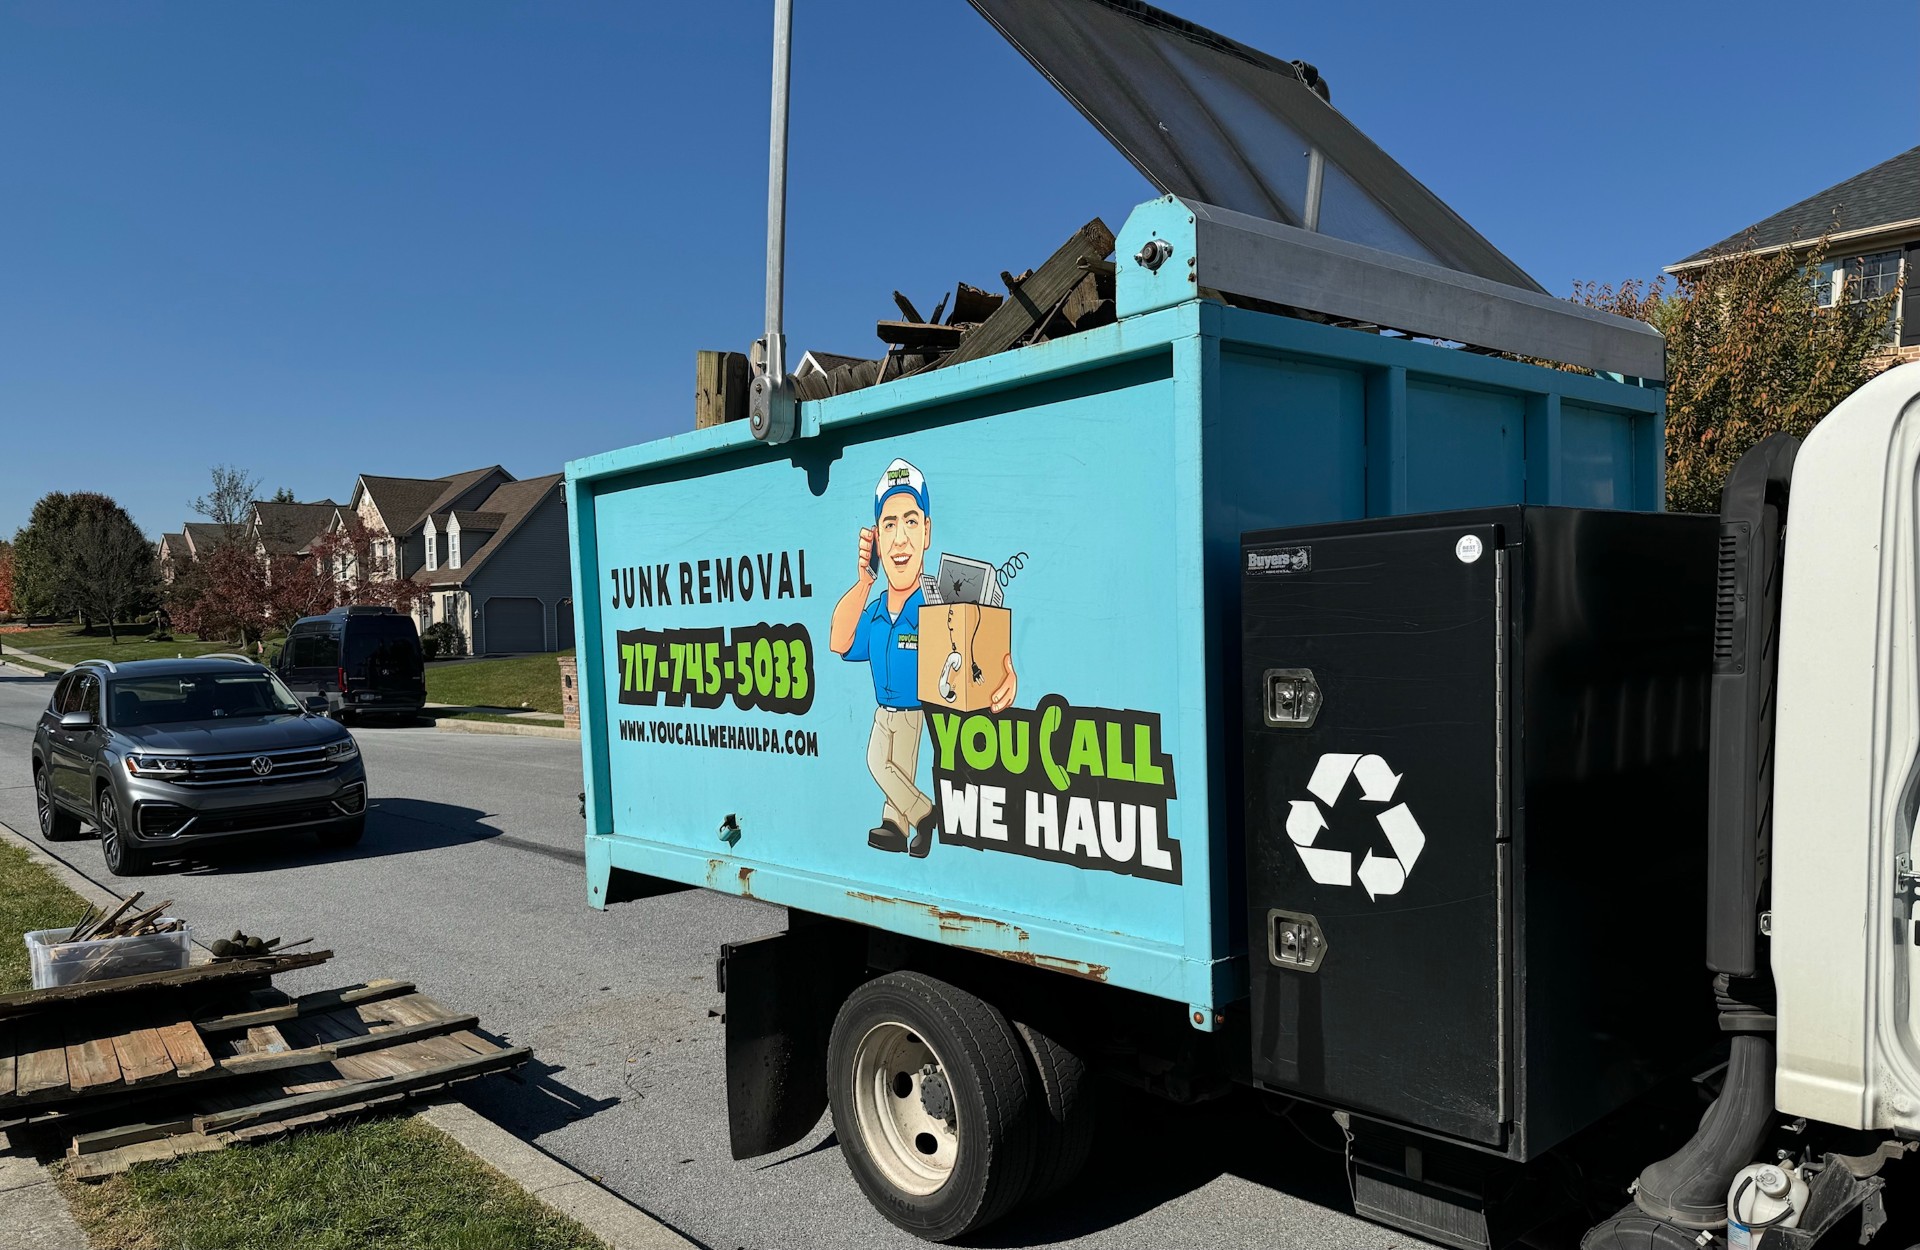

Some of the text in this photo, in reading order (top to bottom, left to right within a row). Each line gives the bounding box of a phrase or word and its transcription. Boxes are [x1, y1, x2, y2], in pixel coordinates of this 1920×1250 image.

[611, 549, 812, 609] JUNK REMOVAL
[1248, 553, 1290, 569] Buyers
[621, 638, 809, 699] 717-745-5033
[619, 719, 819, 757] WWW.YOUCALLWEHAULPA.COM
[932, 713, 1030, 774] YOU
[940, 779, 1173, 871] WE HAUL
